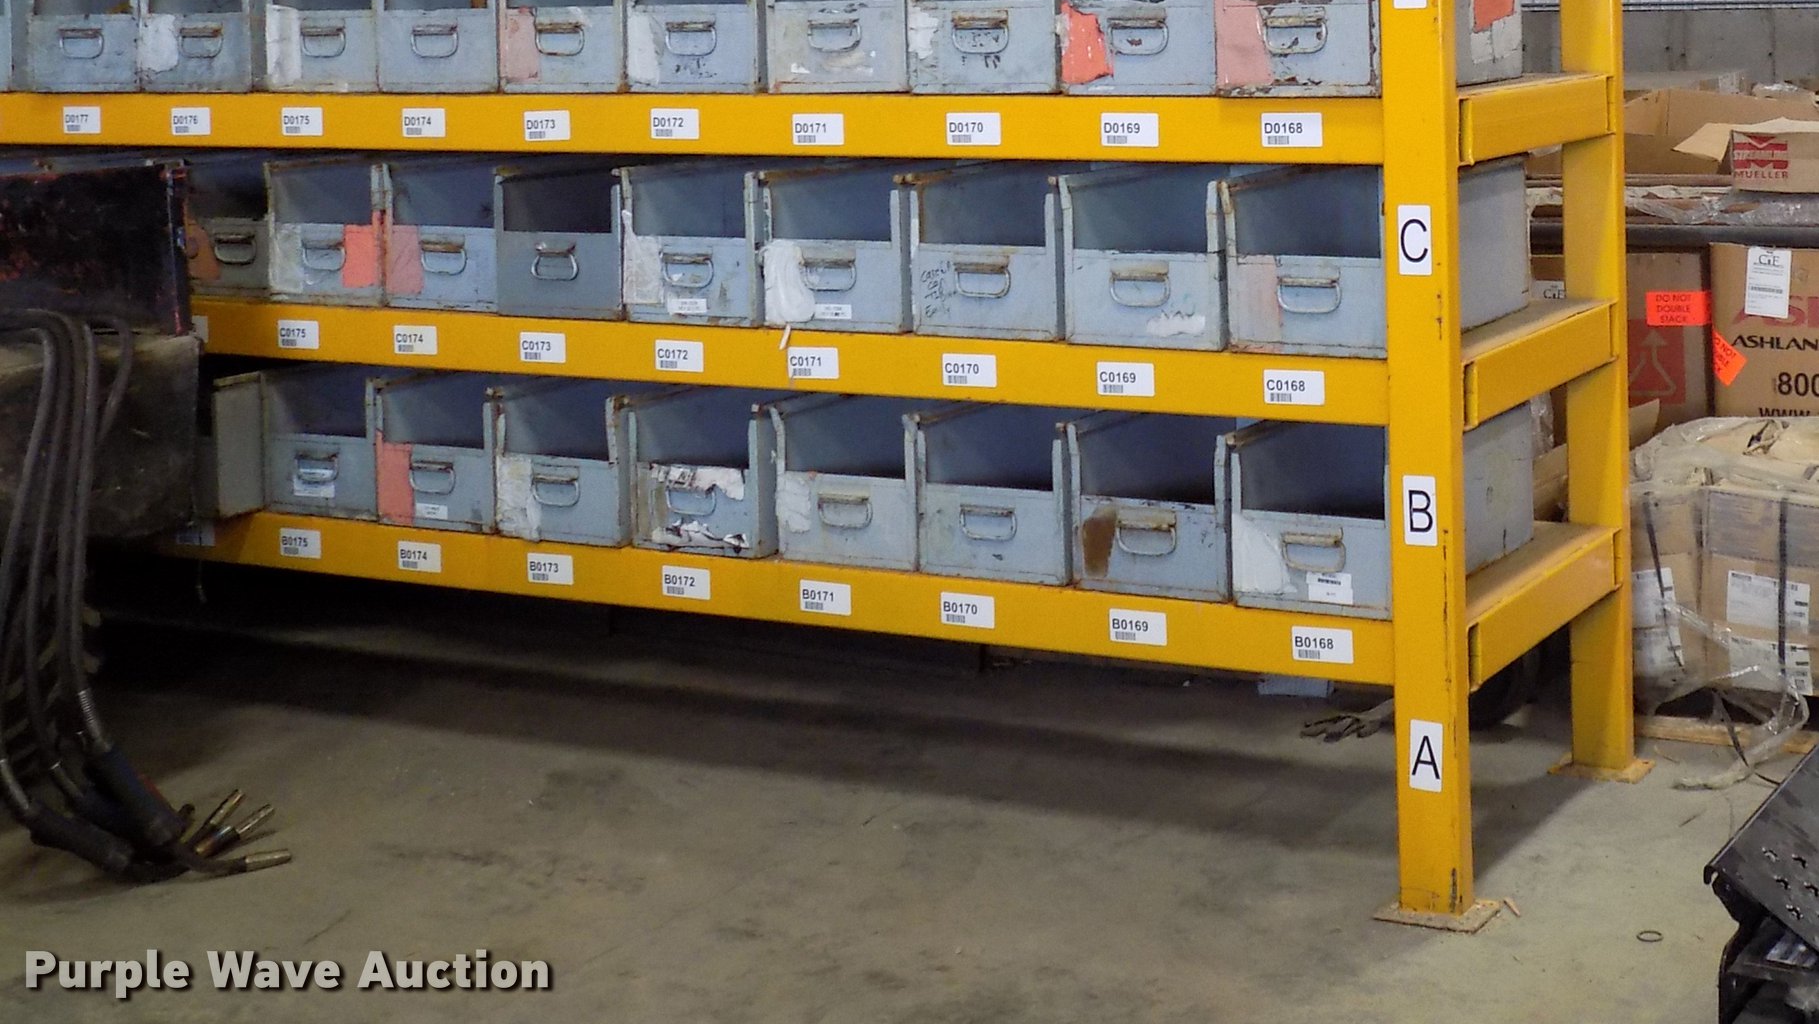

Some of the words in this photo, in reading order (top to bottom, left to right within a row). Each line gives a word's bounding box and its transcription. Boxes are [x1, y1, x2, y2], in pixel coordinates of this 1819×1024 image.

[65, 114, 88, 125] D0177
[172, 115, 198, 126] D0176
[283, 115, 310, 126] D0175
[404, 116, 432, 127] D0174
[526, 119, 556, 131] D0173
[652, 116, 684, 128] D0172
[795, 122, 827, 134] D0171
[949, 121, 984, 133] D0170
[1103, 122, 1140, 135] D0169
[1263, 122, 1303, 135] D0168
[1734, 170, 1789, 179] MUELLER
[1400, 218, 1428, 263] C
[1655, 295, 1671, 303] DO
[1672, 294, 1691, 302] NOT
[279, 328, 306, 338] C0175
[396, 333, 423, 344] C0174
[522, 340, 551, 351] C0173
[1731, 335, 1819, 352] ASHLAN
[658, 347, 688, 359] C0172
[790, 355, 822, 368] C0171
[944, 362, 979, 374] C0170
[1099, 370, 1136, 384] C0169
[1266, 379, 1306, 393] C0168
[1408, 489, 1433, 533] B
[282, 535, 308, 547] B0175
[400, 549, 427, 561] B0174
[529, 561, 558, 573] B0173
[664, 574, 695, 587] B0172
[802, 588, 835, 602] B0171
[943, 601, 978, 615] B0170
[1112, 618, 1148, 632] B0169
[1294, 635, 1334, 650] B0168
[1411, 735, 1441, 780] A
